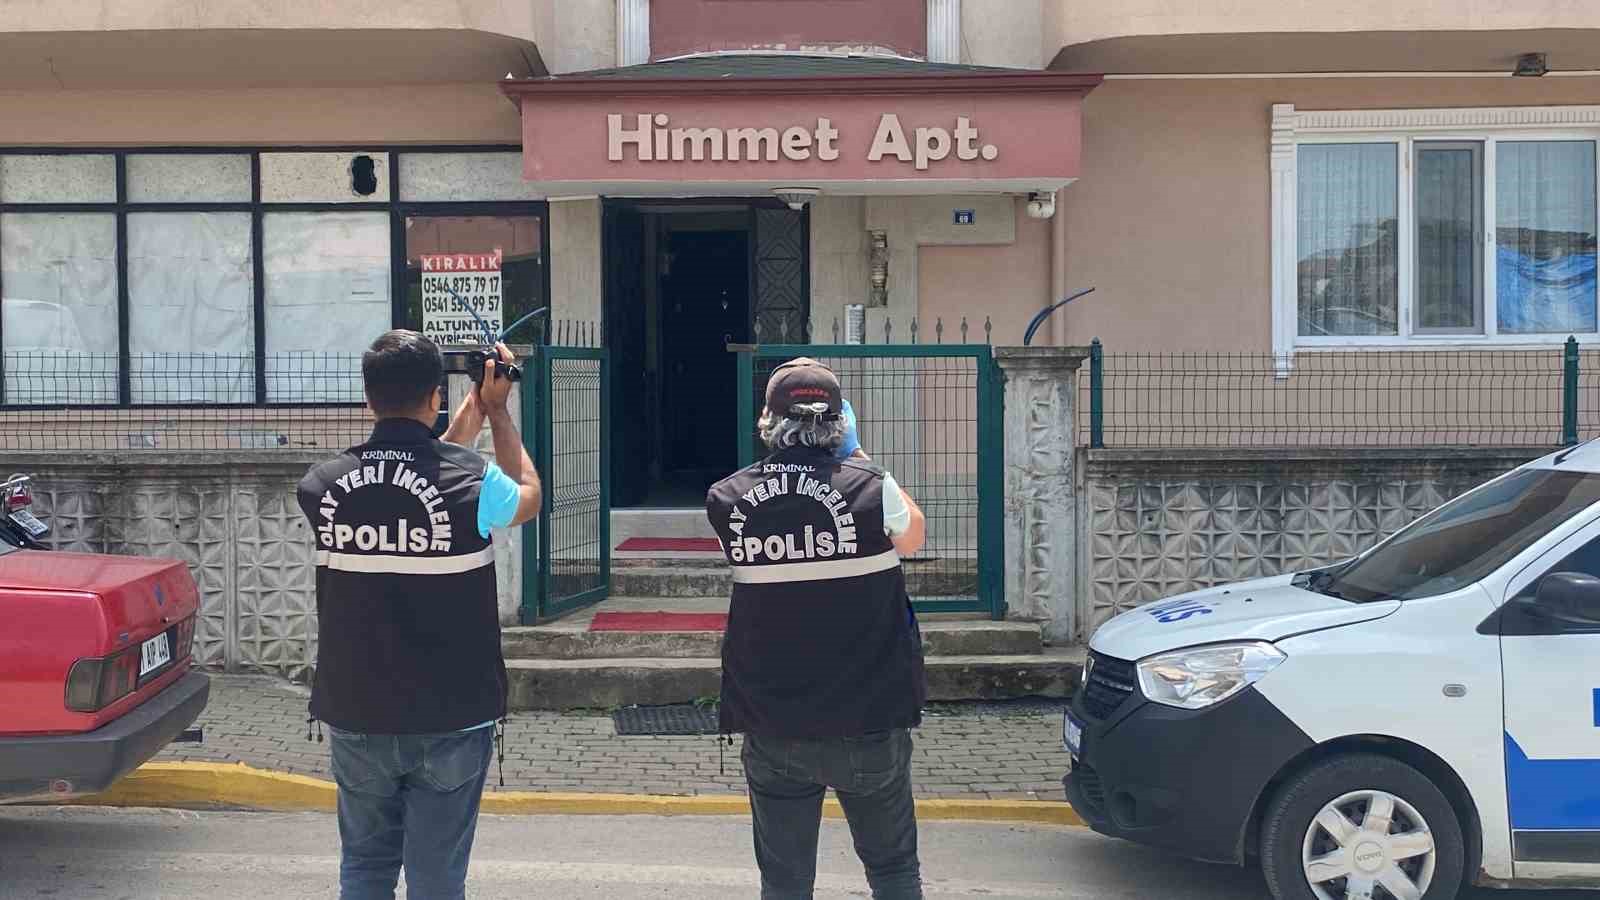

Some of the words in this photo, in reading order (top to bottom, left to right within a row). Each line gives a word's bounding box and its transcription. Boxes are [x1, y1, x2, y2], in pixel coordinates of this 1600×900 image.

[607, 113, 839, 161] Himmet
[867, 113, 999, 170] Apt.
[424, 277, 449, 294] 0546
[453, 276, 471, 293] 875
[474, 276, 486, 293] 79
[489, 276, 499, 293] 17
[424, 297, 448, 312] 0541
[472, 295, 485, 312] 99
[488, 295, 500, 312] 57
[318, 489, 340, 548] OLAY
[728, 505, 747, 562] OLAY
